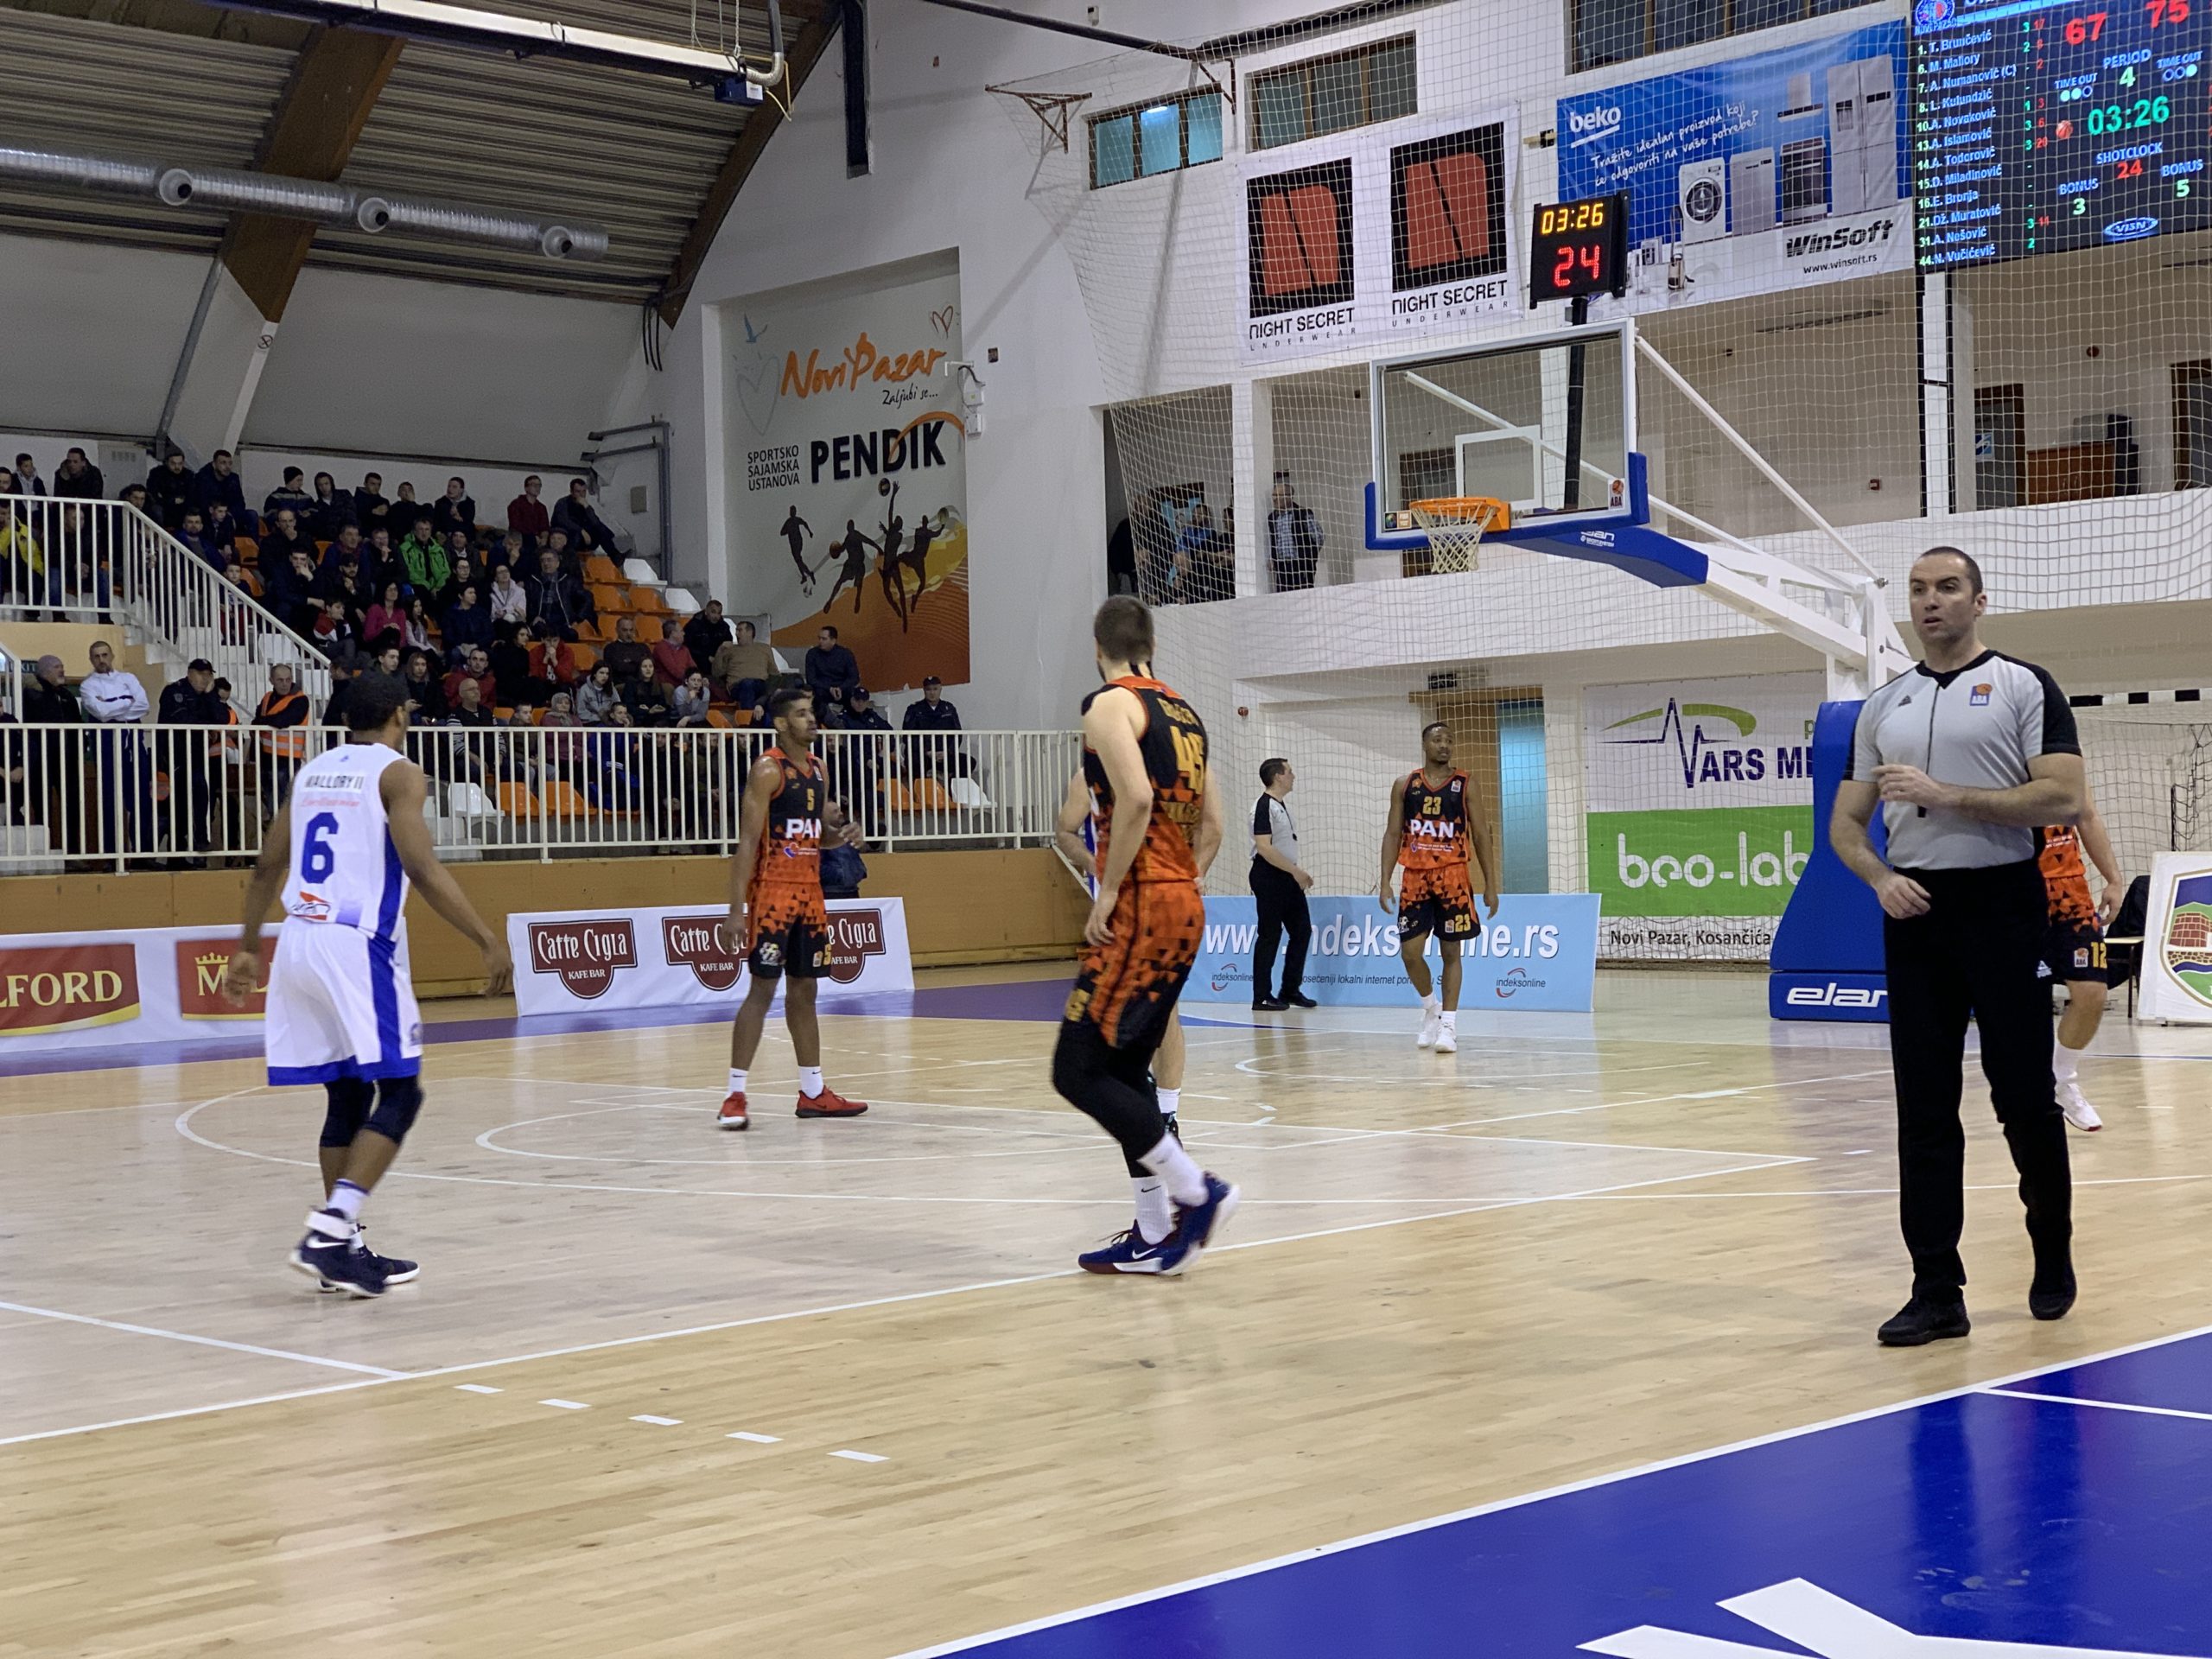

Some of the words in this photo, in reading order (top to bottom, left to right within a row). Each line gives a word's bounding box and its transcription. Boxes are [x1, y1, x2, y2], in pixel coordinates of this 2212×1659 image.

[2145, 0, 2190, 29] 75
[2023, 22, 2030, 33] 3
[2065, 12, 2107, 44] 67
[2024, 41, 2031, 53] 2
[2103, 49, 2152, 69] PERIOD
[2119, 67, 2136, 86] 4
[2037, 98, 2045, 108] 3
[1569, 105, 1622, 134] beko
[2088, 95, 2170, 135] 03:26
[1591, 148, 1633, 170] Tražite
[1637, 130, 1675, 154] idealan
[1679, 113, 1723, 140] proizvod
[1726, 100, 1745, 118] koji
[2024, 120, 2032, 131] 3
[1611, 155, 1661, 181] odgovoriti
[1664, 148, 1678, 159] na
[1682, 136, 1708, 153] vaše
[1712, 110, 1758, 145] potrebe?
[2025, 139, 2032, 150] 3
[2096, 142, 2163, 164] SHOTCLOCK
[2117, 159, 2143, 179] 24
[2161, 159, 2203, 177] BONUS
[2059, 178, 2099, 195] BONUS
[2176, 179, 2190, 198] 5
[2072, 198, 2086, 215] 3
[1541, 203, 1605, 235] 03:26
[2027, 218, 2035, 229] 3
[1786, 219, 1894, 257] WinSoft
[2027, 238, 2035, 249] 2
[1554, 245, 1601, 289] 24
[1803, 254, 1878, 274] www.winsoft.rs
[1443, 281, 1507, 306] SECRET
[1297, 308, 1355, 331] SECRET
[780, 347, 847, 399] Novi
[844, 332, 947, 391] Pazar
[882, 383, 918, 410] Zaljubi
[747, 444, 799, 465] SPORTSKO
[810, 420, 946, 484] PENDIK
[747, 459, 800, 478] SAJAMSKA
[748, 473, 800, 492] USTANOVA
[1423, 797, 1442, 815] 23
[1410, 818, 1454, 838] PAN
[301, 812, 339, 884] 6
[1455, 913, 1471, 932] 23
[1611, 930, 1643, 944] Novi
[1649, 930, 1691, 947] Pazar,
[1696, 929, 1770, 944] Kosančića
[830, 957, 843, 965] AFE
[2091, 942, 2107, 968] 12
[568, 969, 588, 980] KAFE
[589, 969, 605, 978] BAR
[700, 963, 718, 972] KAFE
[719, 962, 734, 971] BAR
[0, 969, 122, 1007] FORD
[1338, 975, 1363, 984] lokalni
[1365, 975, 1395, 984] internet
[1496, 976, 1546, 988] indeksonline
